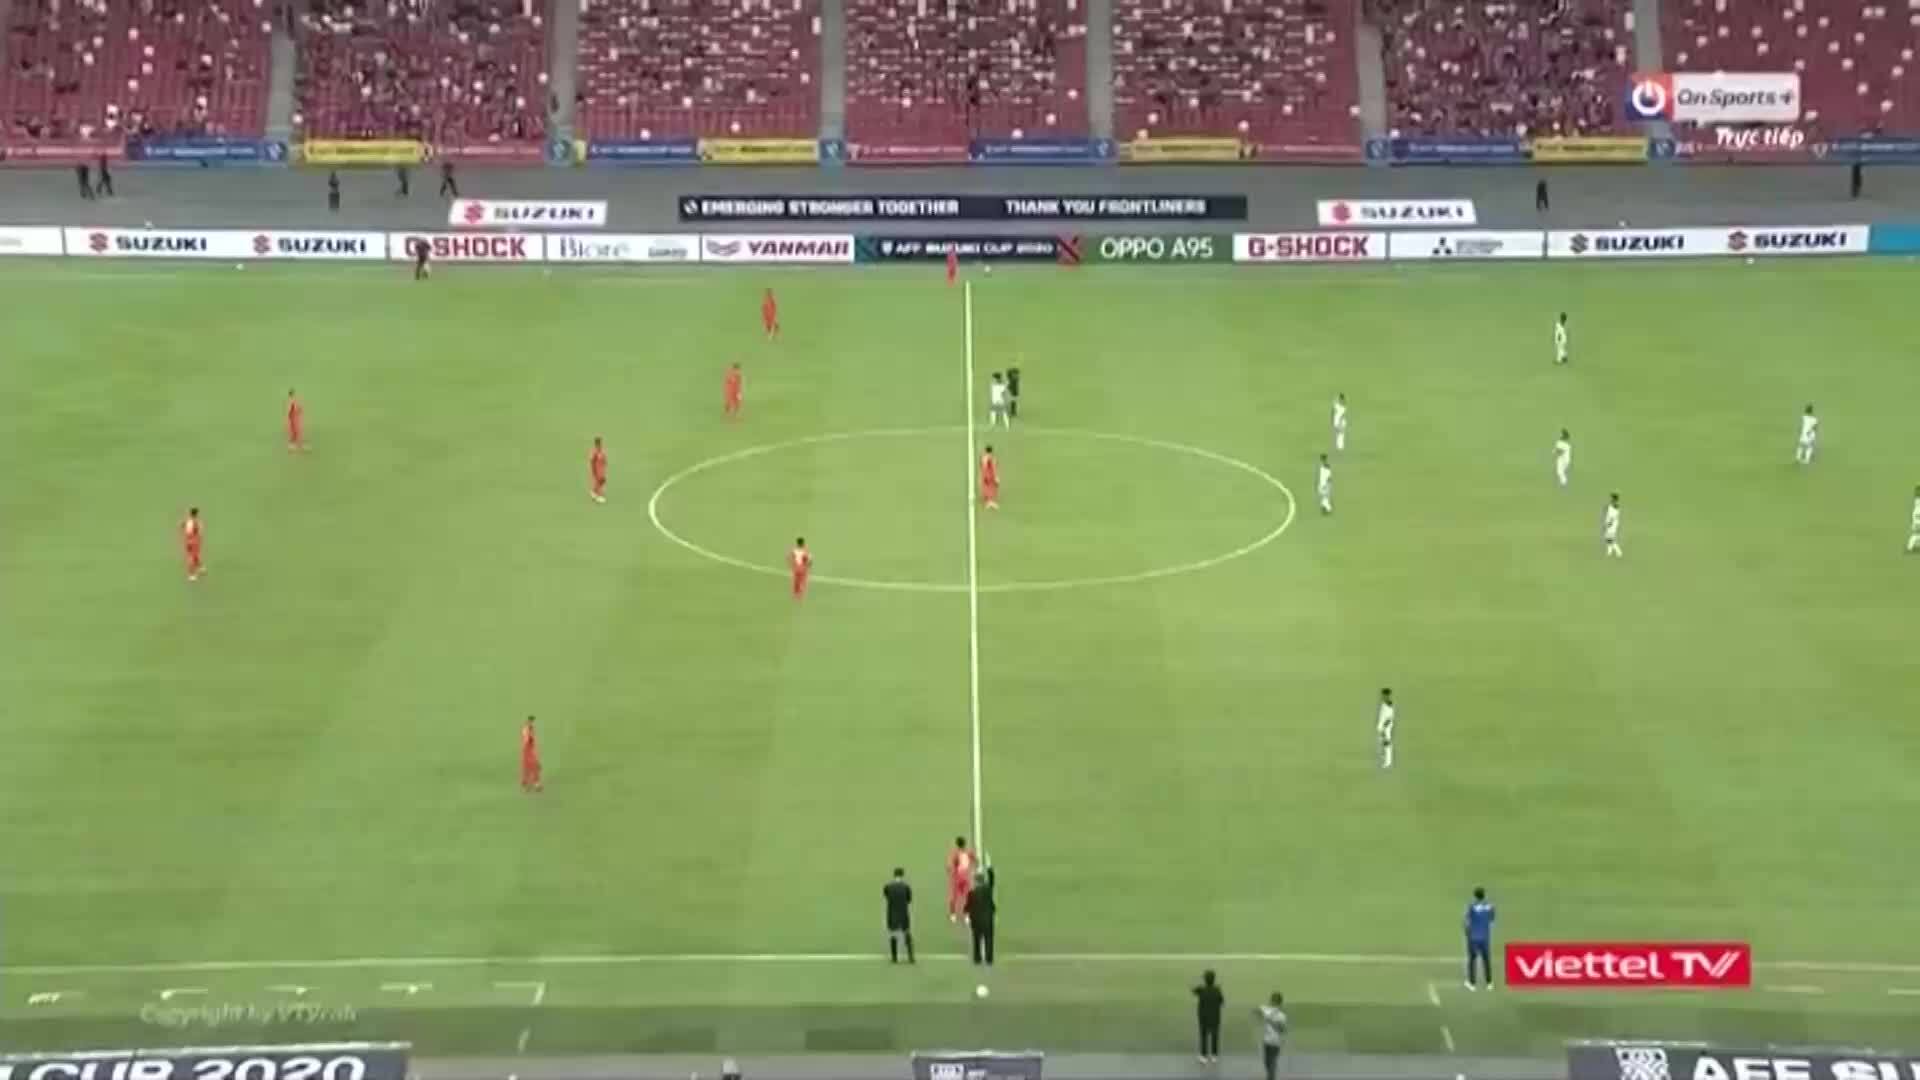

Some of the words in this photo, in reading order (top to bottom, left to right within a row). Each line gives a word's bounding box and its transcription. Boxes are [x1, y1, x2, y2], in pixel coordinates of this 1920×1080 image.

[494, 206, 594, 220] SUZUKI
[702, 200, 784, 214] EMERGING
[788, 200, 873, 214] STRONGER
[877, 200, 959, 214] TOGETHER
[1005, 199, 1059, 214] THANK
[1063, 199, 1096, 214] YOU
[1099, 199, 1206, 214] FRONTLINERS
[1361, 205, 1464, 220] SUZUKI
[115, 238, 208, 253] SUZUKI
[277, 238, 367, 254] SUZUKI
[405, 237, 526, 258] GSHOCK
[1101, 238, 1165, 258] OPPO
[1171, 238, 1214, 258] A95
[1248, 236, 1370, 257] G-SHOCK
[1594, 235, 1685, 251] SUZUKI
[1753, 231, 1847, 249] SUZUKI
[747, 240, 850, 257] YANMAR
